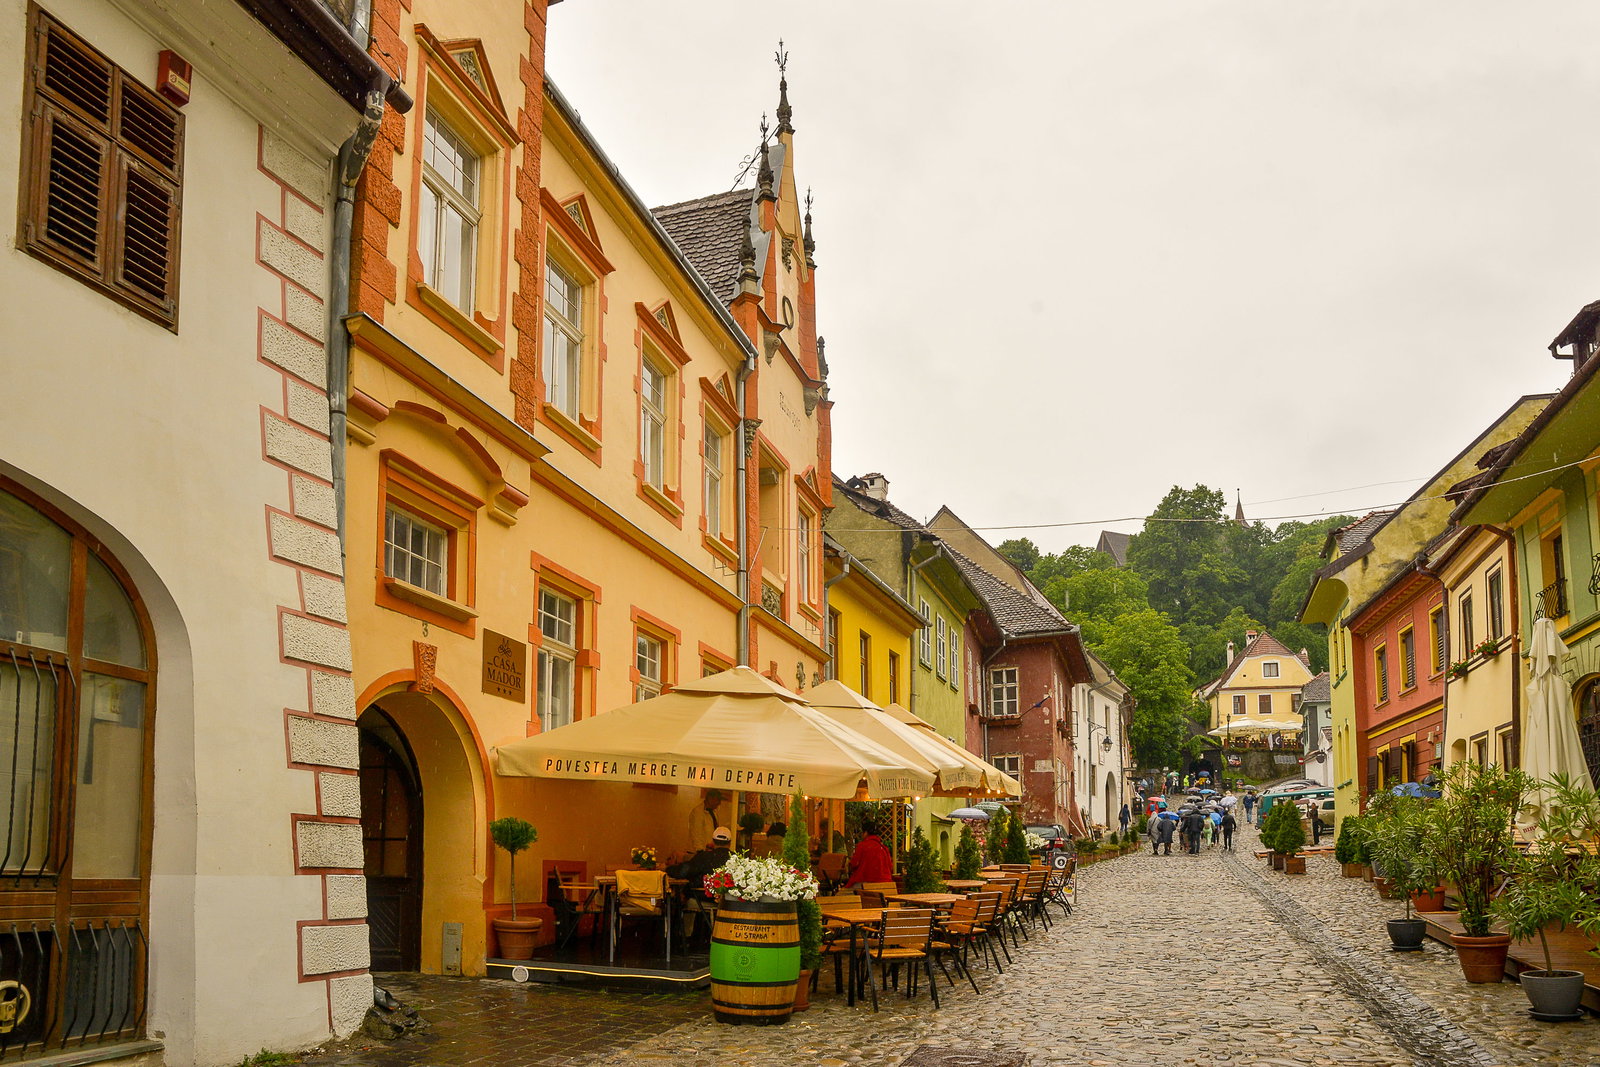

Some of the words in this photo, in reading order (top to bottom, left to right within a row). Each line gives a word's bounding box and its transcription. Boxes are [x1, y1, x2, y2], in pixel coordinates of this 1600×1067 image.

[421, 621, 429, 637] 3
[493, 655, 516, 673] CASA
[487, 667, 521, 689] MADOR
[546, 759, 618, 774] POVESTEA
[628, 762, 678, 777] MERGE
[687, 766, 715, 781] MAI
[725, 769, 795, 788] DEPARTE
[733, 924, 771, 933] RESTAURANT
